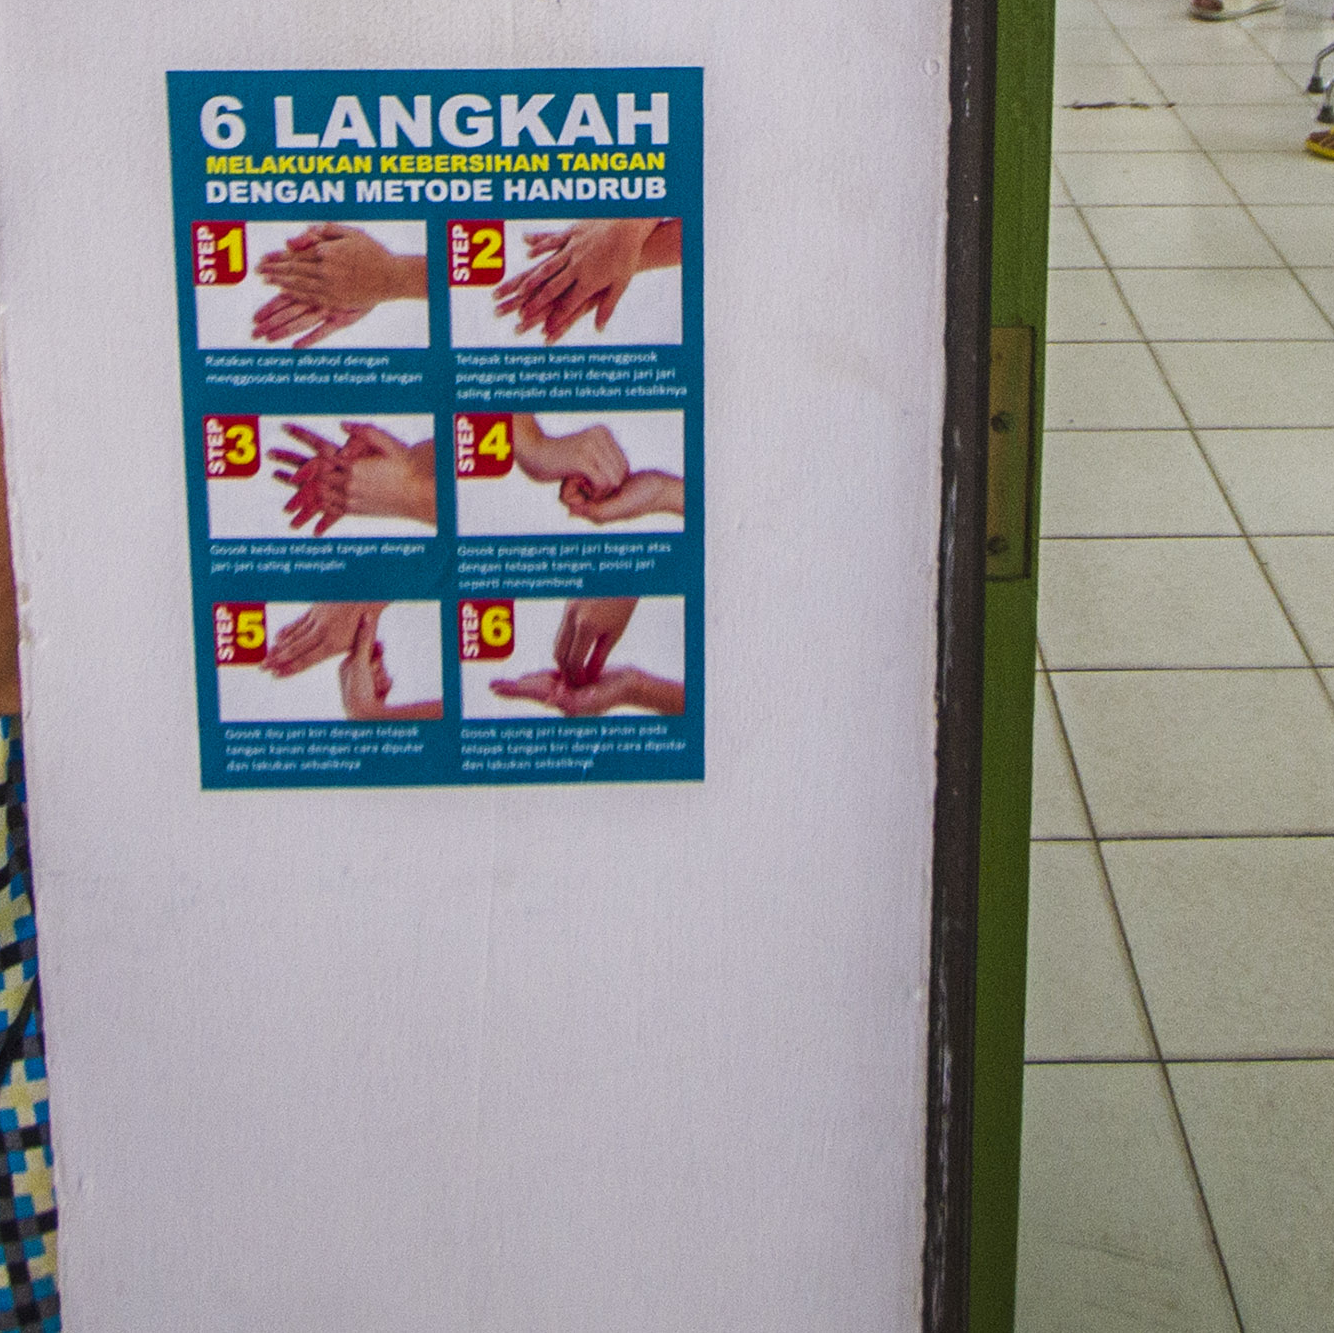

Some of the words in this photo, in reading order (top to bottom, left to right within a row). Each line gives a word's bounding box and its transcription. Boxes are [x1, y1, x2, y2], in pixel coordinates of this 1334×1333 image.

[200, 94, 246, 150] 6
[274, 92, 670, 148] LANGKAH
[205, 155, 372, 174] MELAKUKAN
[380, 153, 550, 173] KEBERSIHAN
[557, 152, 666, 172] TANGAN
[205, 180, 345, 204] DENGAN
[355, 179, 493, 203] METODE
[504, 177, 667, 202] HANDRUB
[197, 225, 217, 283] STEP
[217, 227, 244, 273] 1
[452, 224, 470, 282] STEP
[472, 228, 503, 269] 2
[380, 372, 423, 385] tangan
[456, 353, 501, 366] Telapak
[504, 353, 546, 366] tangan
[548, 352, 585, 363] kanan
[588, 351, 657, 365] menggosok
[456, 371, 515, 384] punggung
[519, 370, 560, 383] tangan
[564, 369, 583, 380] kiri
[586, 368, 630, 382] dengan
[634, 368, 653, 381] jari
[656, 368, 675, 381] jari
[456, 388, 491, 401] saling
[494, 387, 546, 400] menjalin
[549, 386, 572, 398] dan
[575, 385, 621, 397] lakukan
[625, 384, 687, 397] sebaliknya
[206, 418, 226, 474] STEP
[226, 424, 256, 465] 3
[457, 416, 475, 472] STEP
[478, 421, 511, 462] 4
[458, 561, 502, 574] dengan
[505, 560, 548, 573] telapak
[216, 606, 235, 661] STEP
[236, 609, 265, 649] 5
[462, 603, 480, 657] STEP
[481, 605, 512, 647] 6
